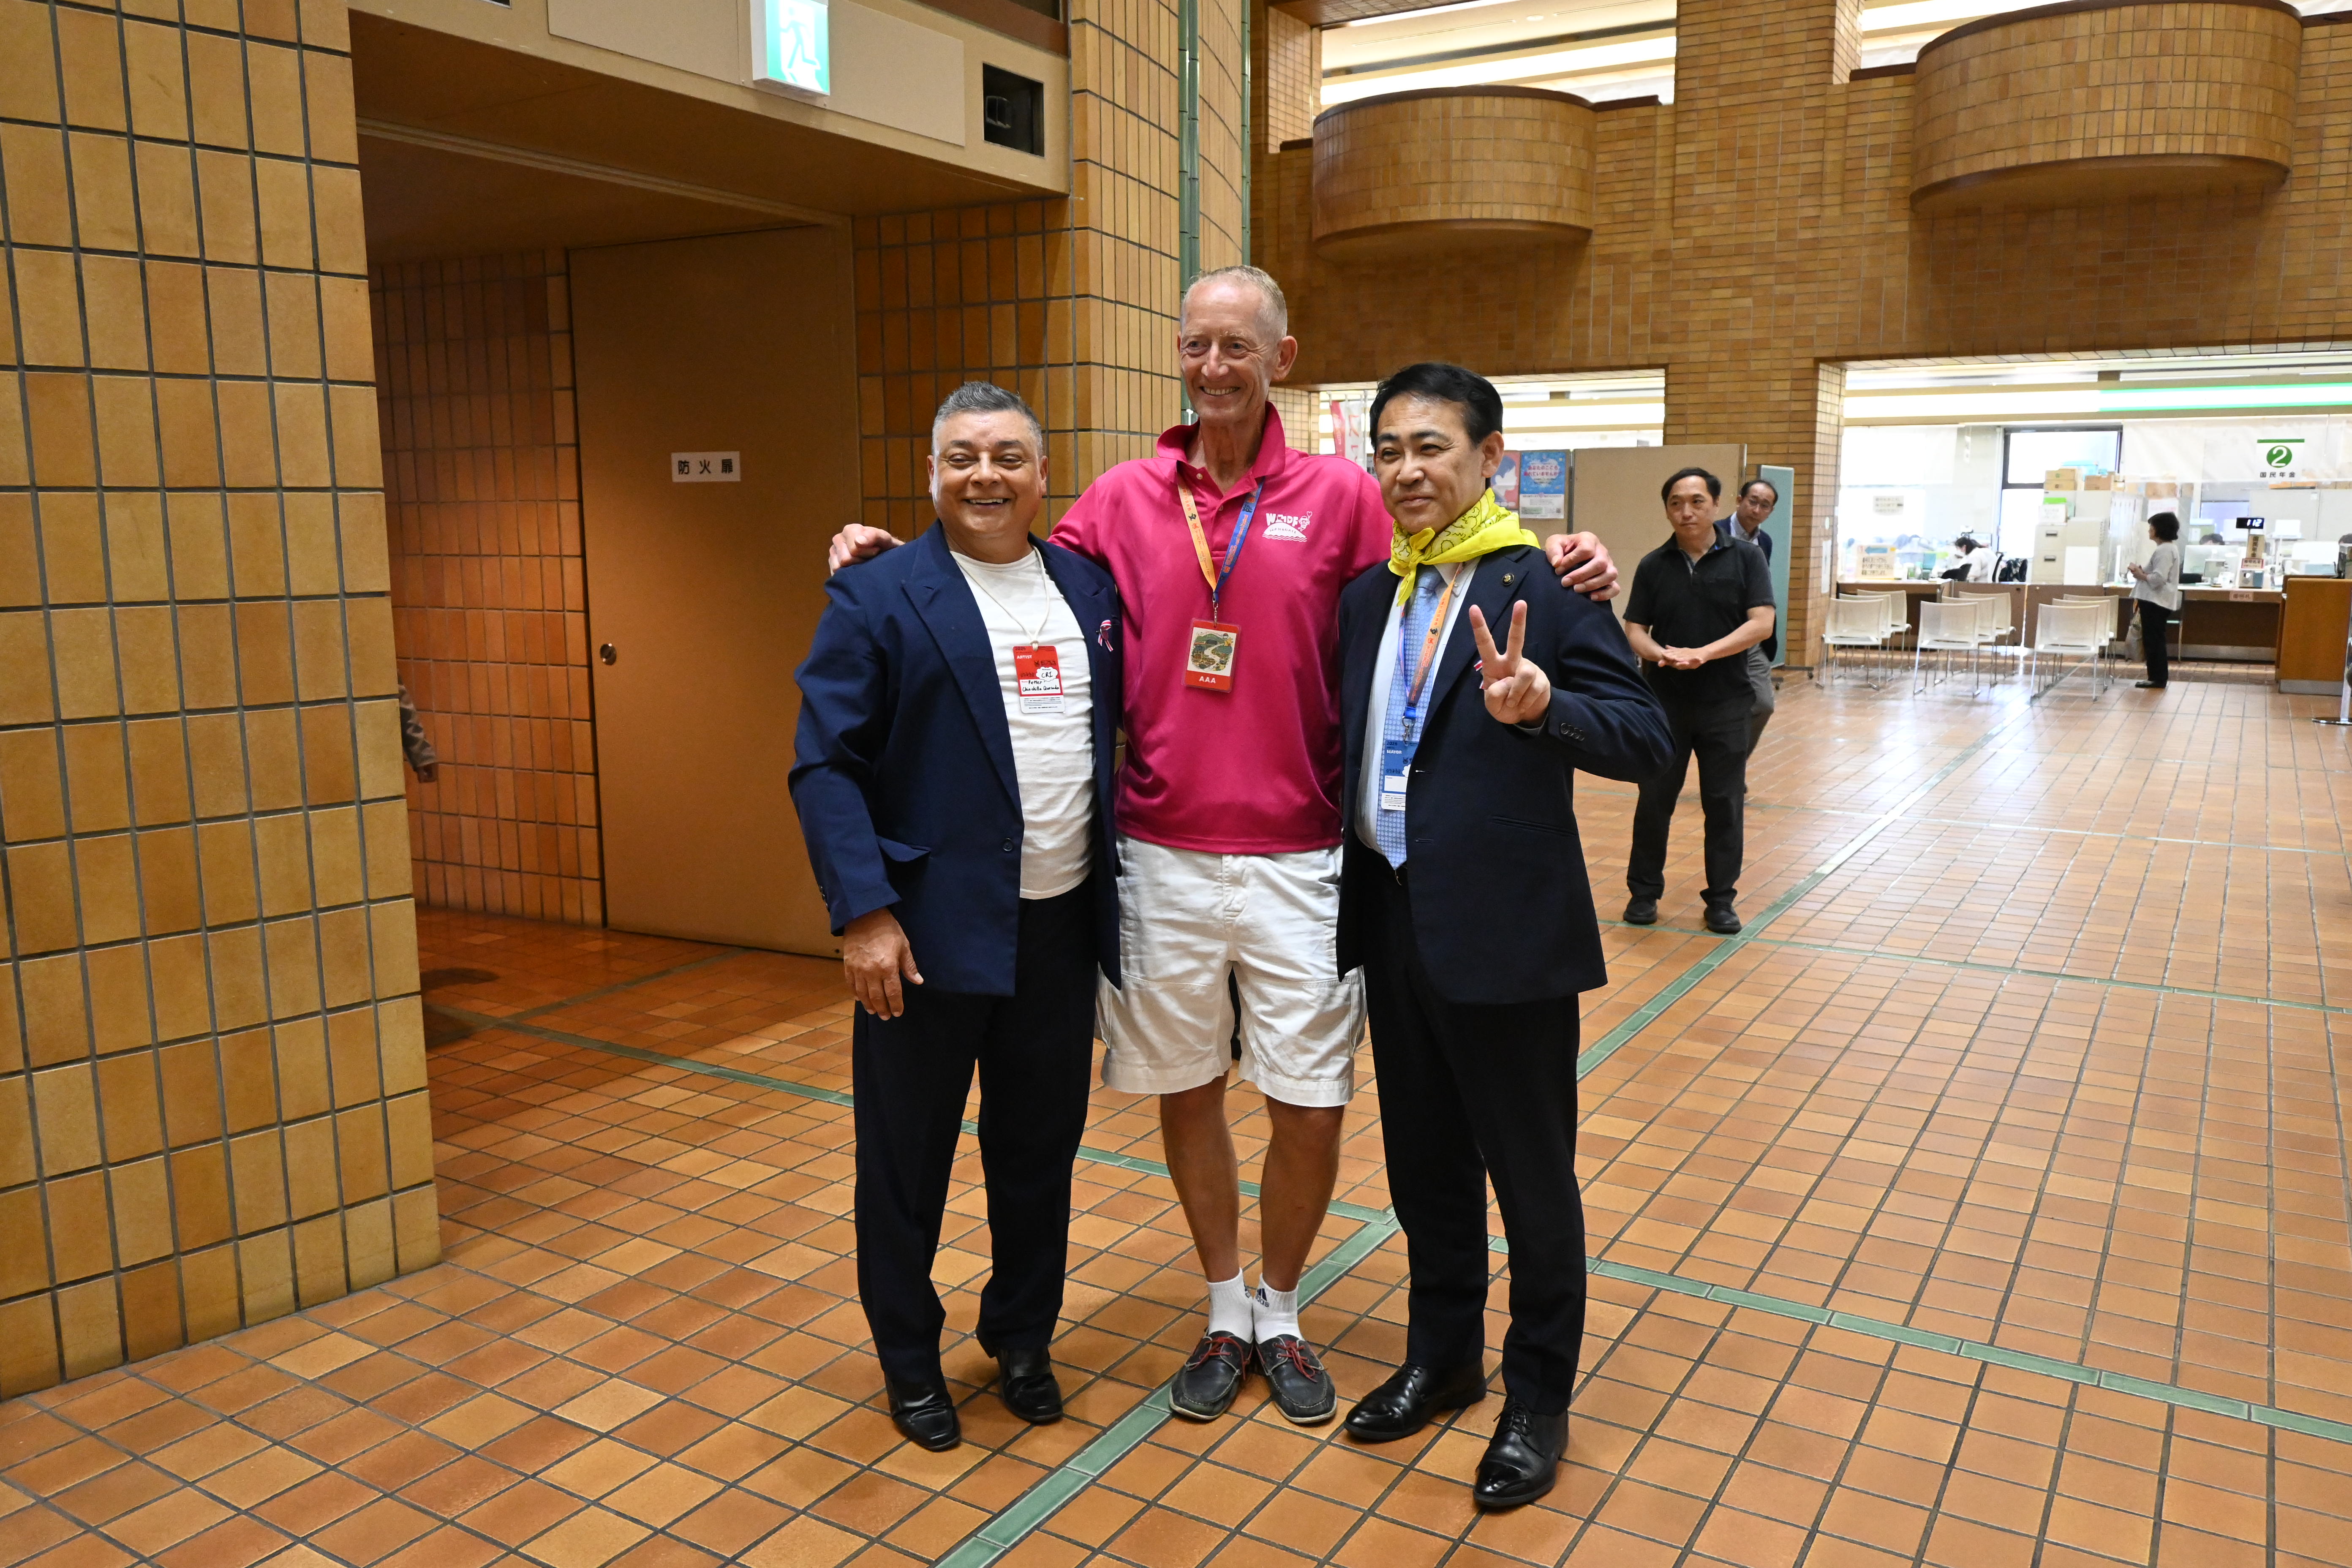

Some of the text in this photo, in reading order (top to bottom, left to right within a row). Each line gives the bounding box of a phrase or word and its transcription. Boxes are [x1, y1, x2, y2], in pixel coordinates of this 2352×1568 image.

[2271, 446, 2287, 466] 2
[678, 459, 733, 475] 防火扉
[2246, 519, 2262, 527] 112
[1199, 676, 1216, 684] AAA
